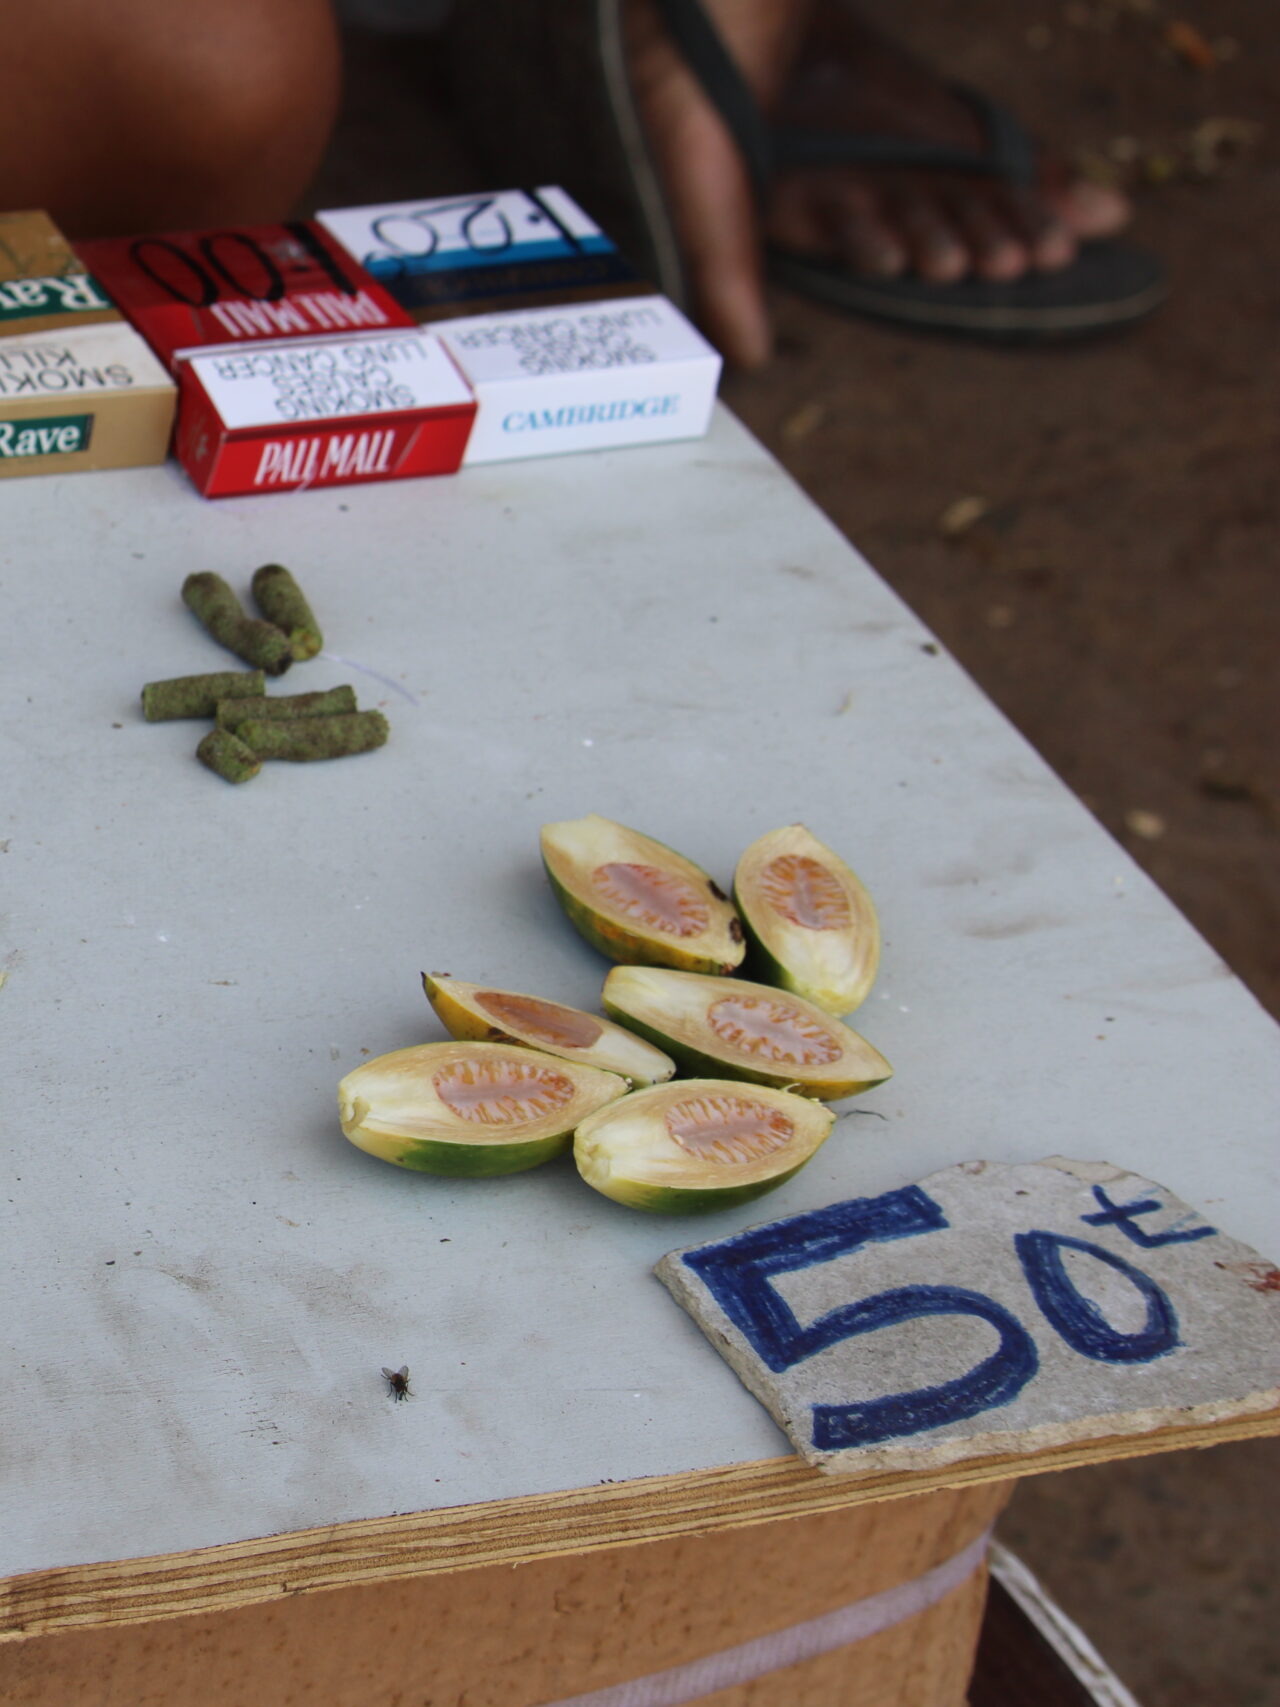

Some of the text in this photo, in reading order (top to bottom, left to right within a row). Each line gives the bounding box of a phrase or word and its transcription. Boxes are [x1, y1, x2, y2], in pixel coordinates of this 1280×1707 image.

[212, 338, 427, 381] LUNG CANCER
[273, 366, 393, 396] CAUSES
[274, 384, 416, 420] SMOKING
[502, 394, 682, 434] CAMBRIDGE
[254, 430, 396, 485] PALL MALL
